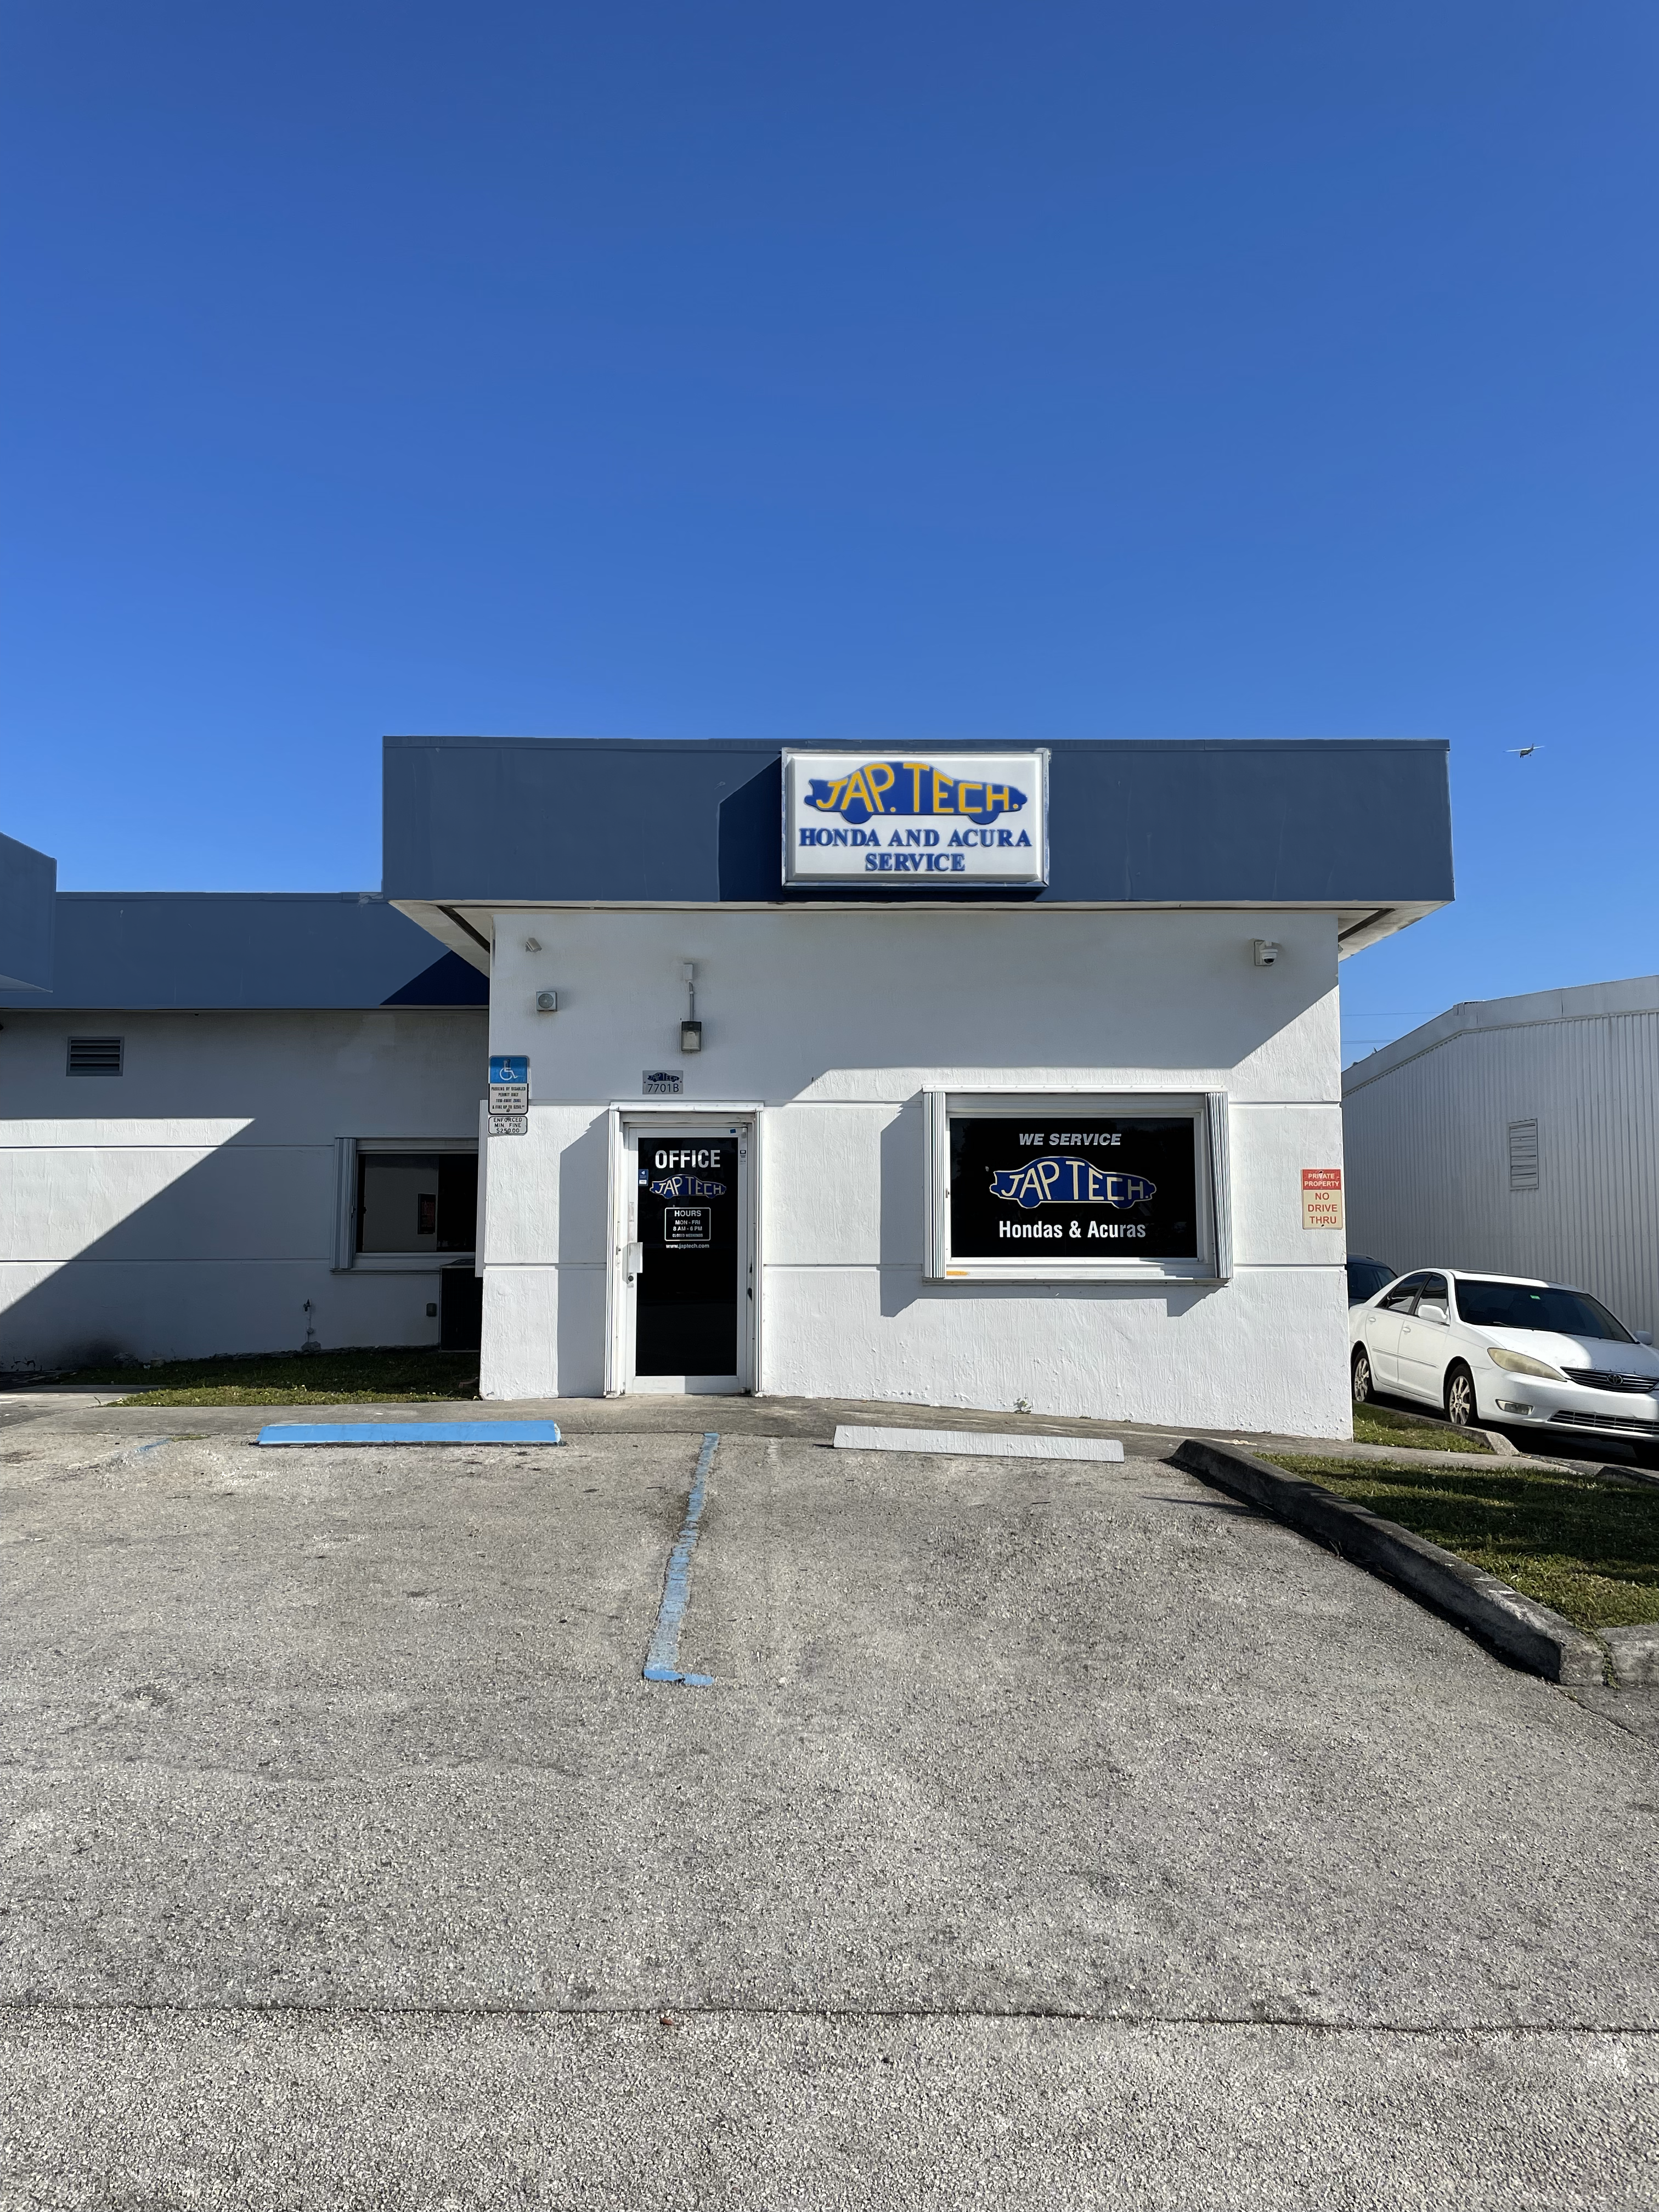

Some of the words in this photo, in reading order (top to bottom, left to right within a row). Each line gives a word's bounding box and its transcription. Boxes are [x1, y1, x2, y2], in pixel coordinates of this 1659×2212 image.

[816, 763, 896, 812] JAP.
[799, 828, 881, 847] HONDA
[888, 828, 940, 847] AND
[947, 828, 1032, 847] ACURA
[865, 853, 966, 872] SERVICE
[648, 1084, 679, 1093] 7701B
[1019, 1133, 1045, 1146] WE
[1048, 1133, 1122, 1146] SERVICE
[655, 1149, 721, 1169] OFFICE
[1001, 1161, 1059, 1200] JAP
[1315, 1192, 1330, 1200] NO
[999, 1220, 1063, 1239] Hondas
[1069, 1220, 1082, 1239] &
[1087, 1220, 1146, 1239] Acuras
[1310, 1216, 1336, 1224] THRU
